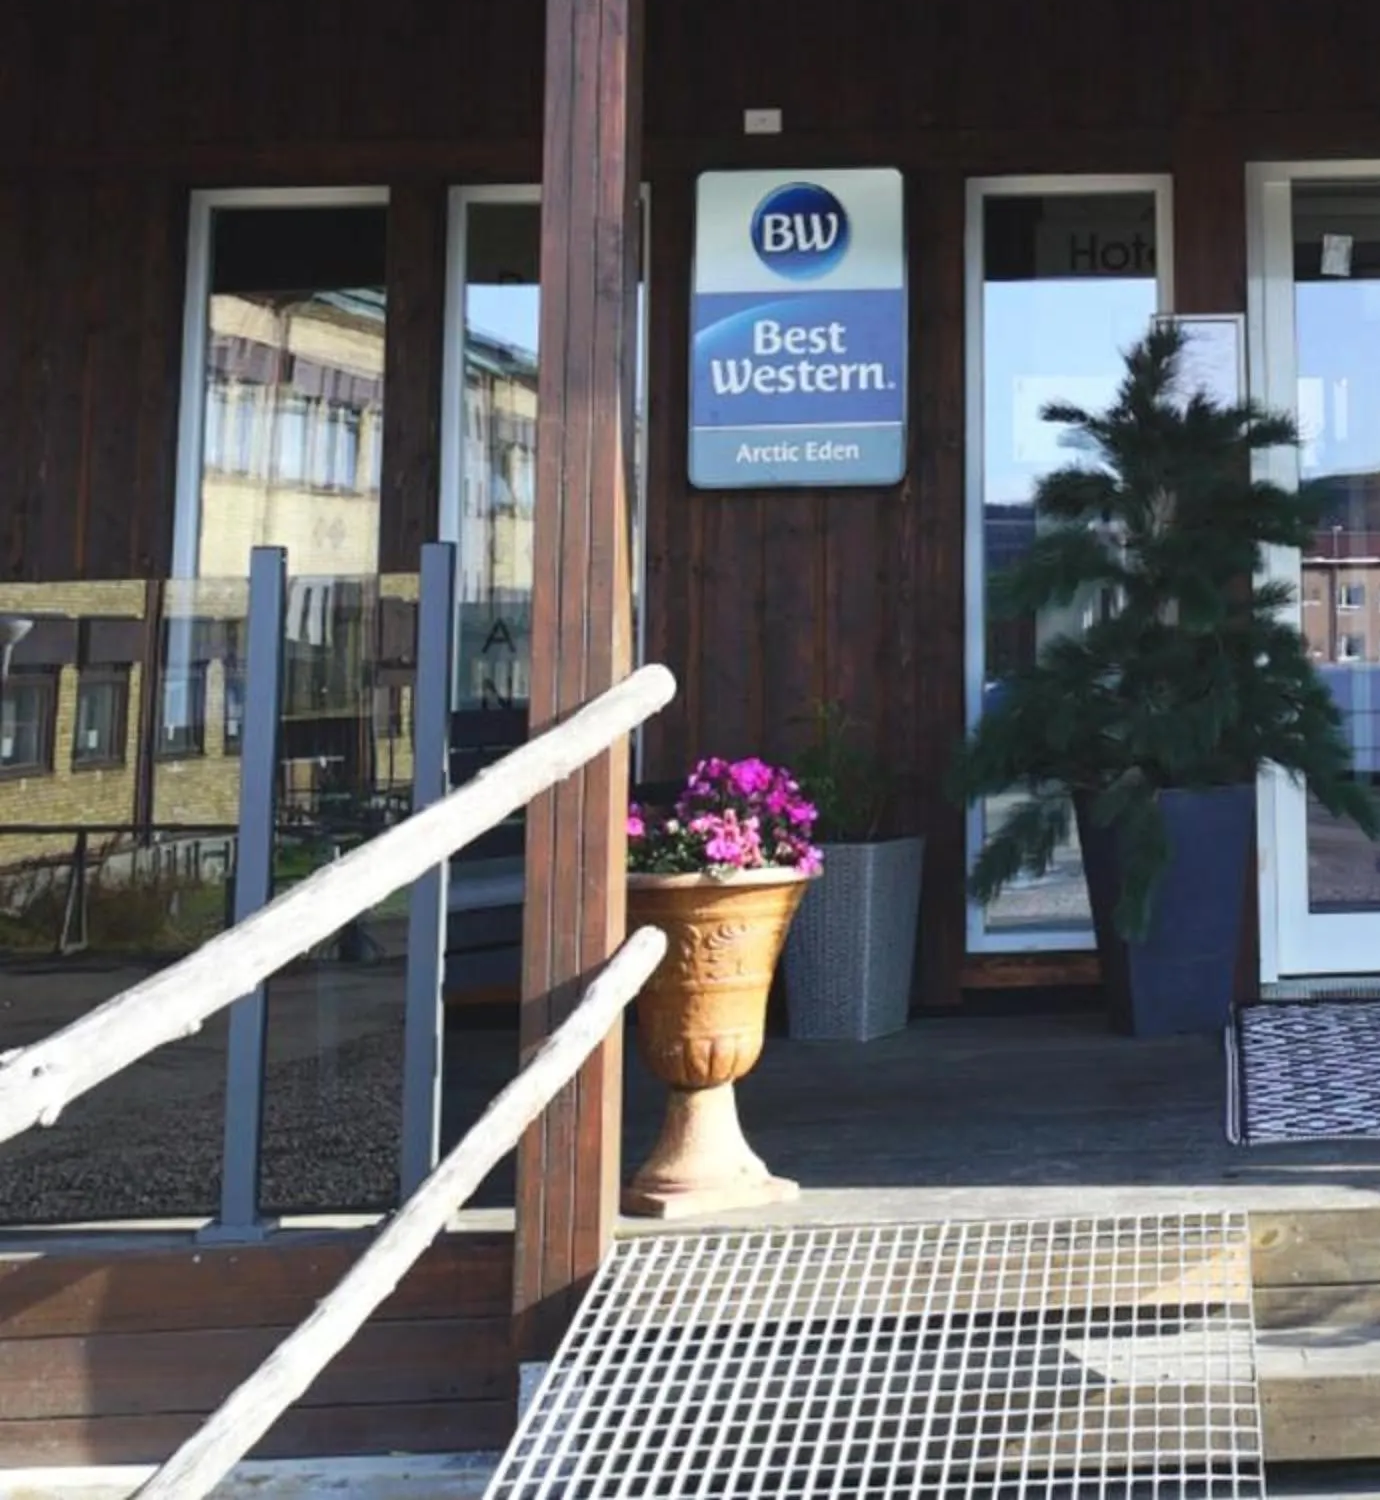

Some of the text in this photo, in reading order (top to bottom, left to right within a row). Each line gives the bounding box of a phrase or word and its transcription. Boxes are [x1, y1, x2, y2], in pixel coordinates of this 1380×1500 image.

[762, 212, 839, 253] BW
[753, 319, 848, 355] Best
[711, 358, 886, 395] Western
[735, 440, 859, 465] Arctic Eden
